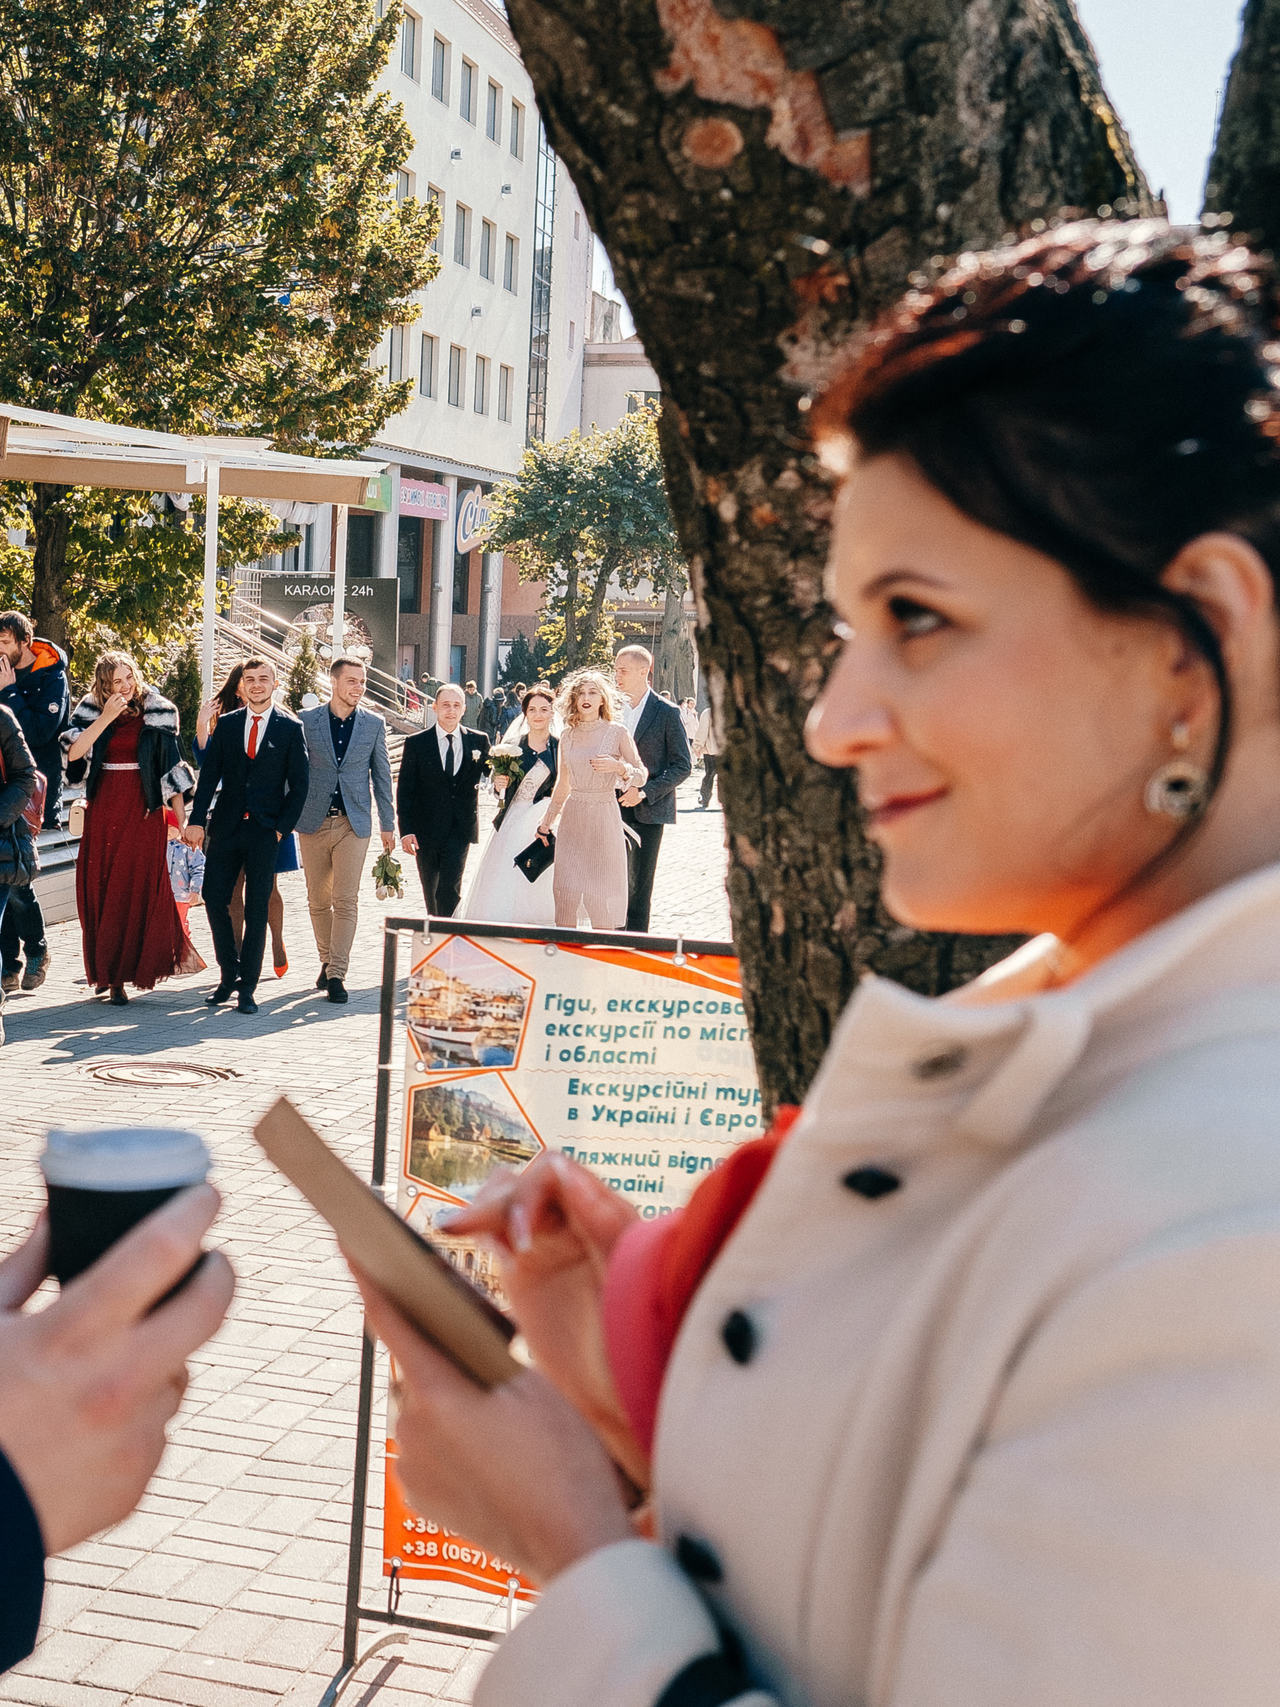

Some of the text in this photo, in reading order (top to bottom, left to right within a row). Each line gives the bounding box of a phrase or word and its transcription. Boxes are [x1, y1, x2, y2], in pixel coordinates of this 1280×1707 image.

[351, 585, 374, 597] 24h
[544, 993, 597, 1016] Гіди,
[545, 1020, 657, 1043] екскурсії
[663, 1025, 691, 1039] по
[545, 1043, 657, 1064] і області
[567, 1078, 708, 1102] Екскурсійні
[567, 1104, 765, 1132] в Україні і Євро
[601, 1174, 664, 1193] раїні
[402, 1540, 438, 1557] +38
[442, 1542, 487, 1569] (067)
